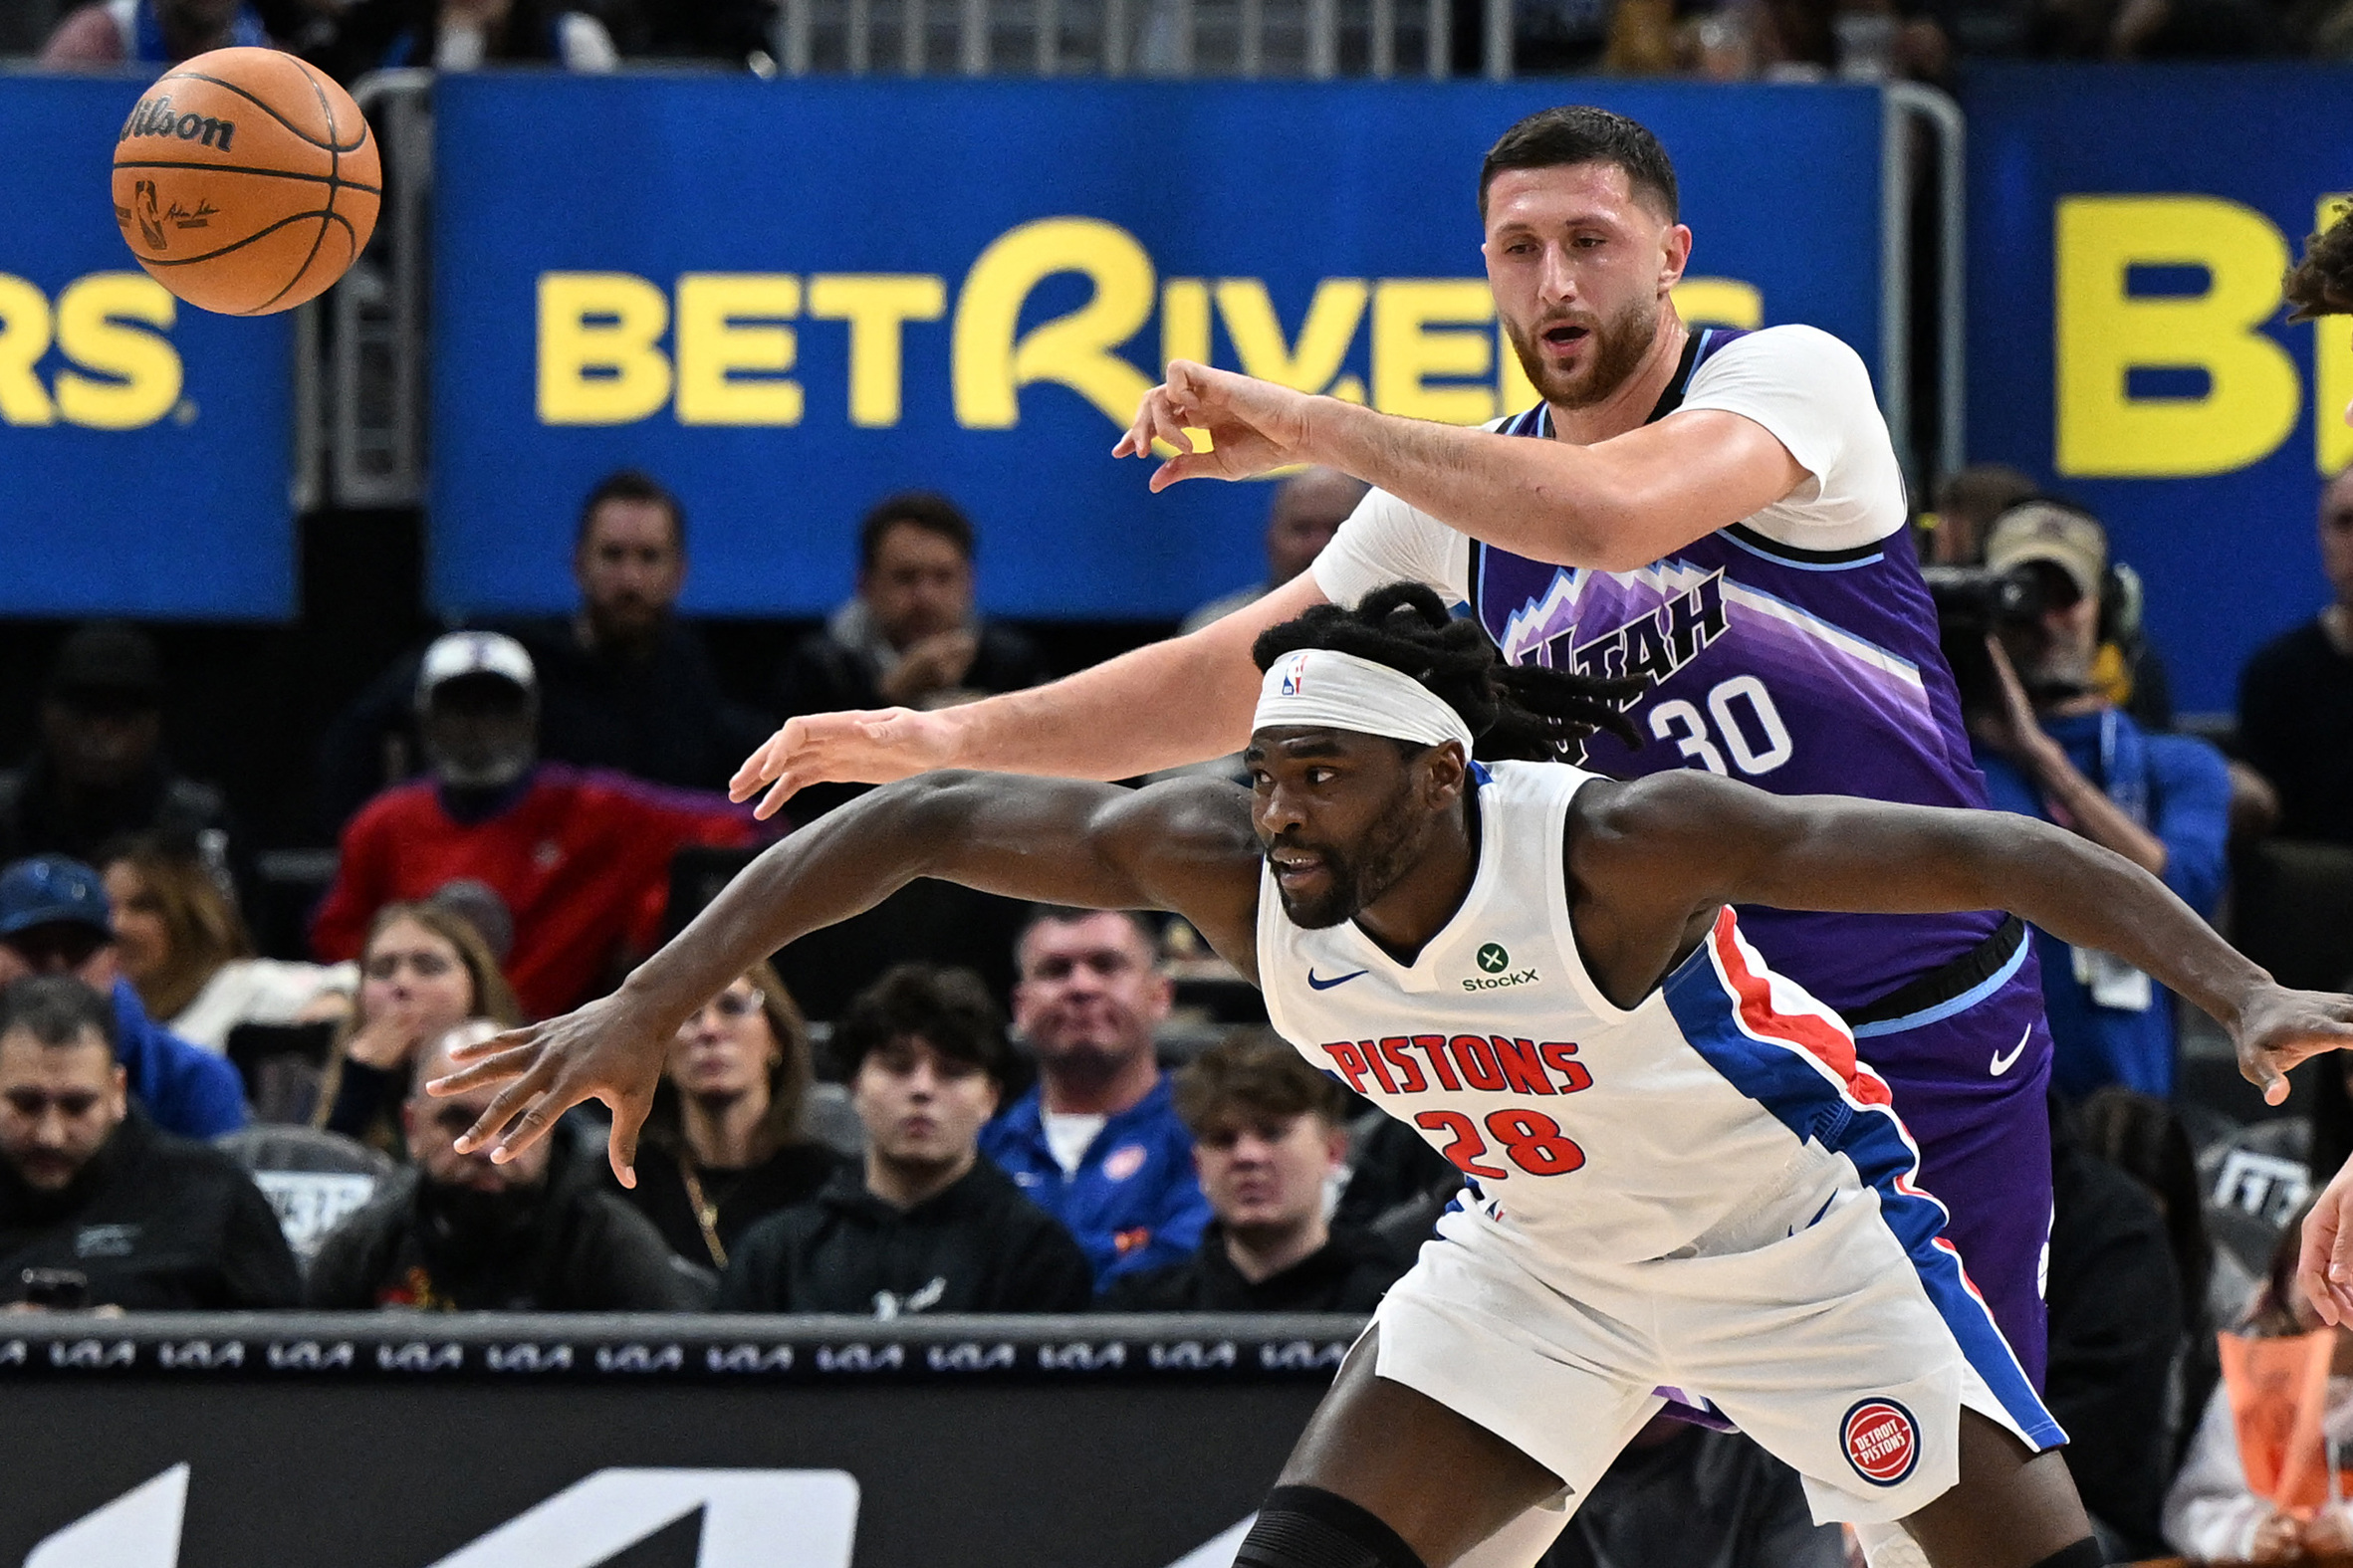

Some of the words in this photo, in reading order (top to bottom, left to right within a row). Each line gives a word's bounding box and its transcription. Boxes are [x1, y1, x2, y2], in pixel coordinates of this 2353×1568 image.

[537, 216, 1763, 482] BETRIVE
[1647, 675, 1792, 776] 30
[1321, 1034, 1593, 1094] PISTONS
[1414, 1109, 1585, 1180] 28
[1854, 1419, 1899, 1452] DETROIT
[1860, 1432, 1906, 1464] PISTONS
